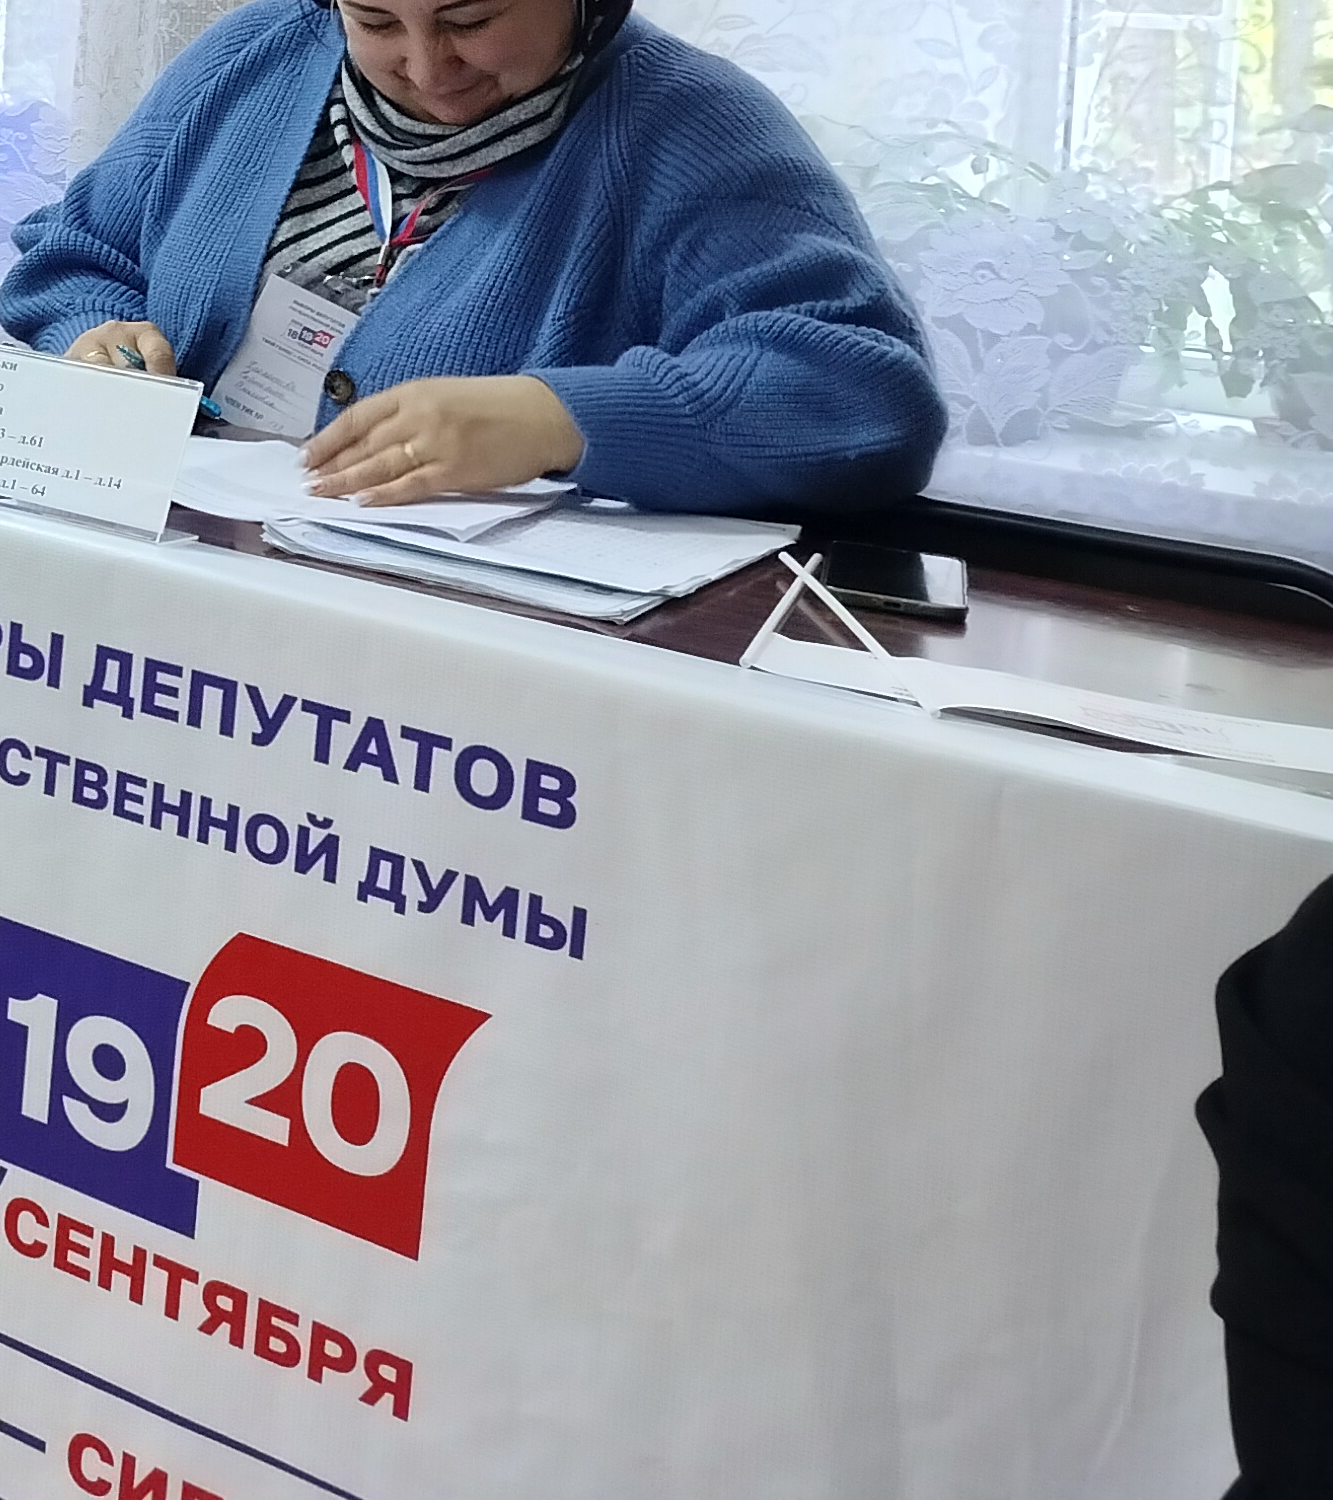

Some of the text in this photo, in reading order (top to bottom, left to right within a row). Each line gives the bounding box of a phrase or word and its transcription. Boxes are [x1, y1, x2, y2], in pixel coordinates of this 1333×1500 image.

[287, 328, 299, 340] 18
[314, 332, 331, 345] 20
[17, 434, 44, 448] д.61
[31, 484, 46, 497] 64
[60, 469, 80, 481] д.1
[93, 476, 122, 490] д.14
[81, 643, 577, 830] ДЕПУТАТОВ
[356, 845, 588, 961] ДУМЫ
[6, 992, 156, 1152] 19
[198, 994, 412, 1177] 20
[3, 1197, 414, 1422] СЕНТЯБРЯ
